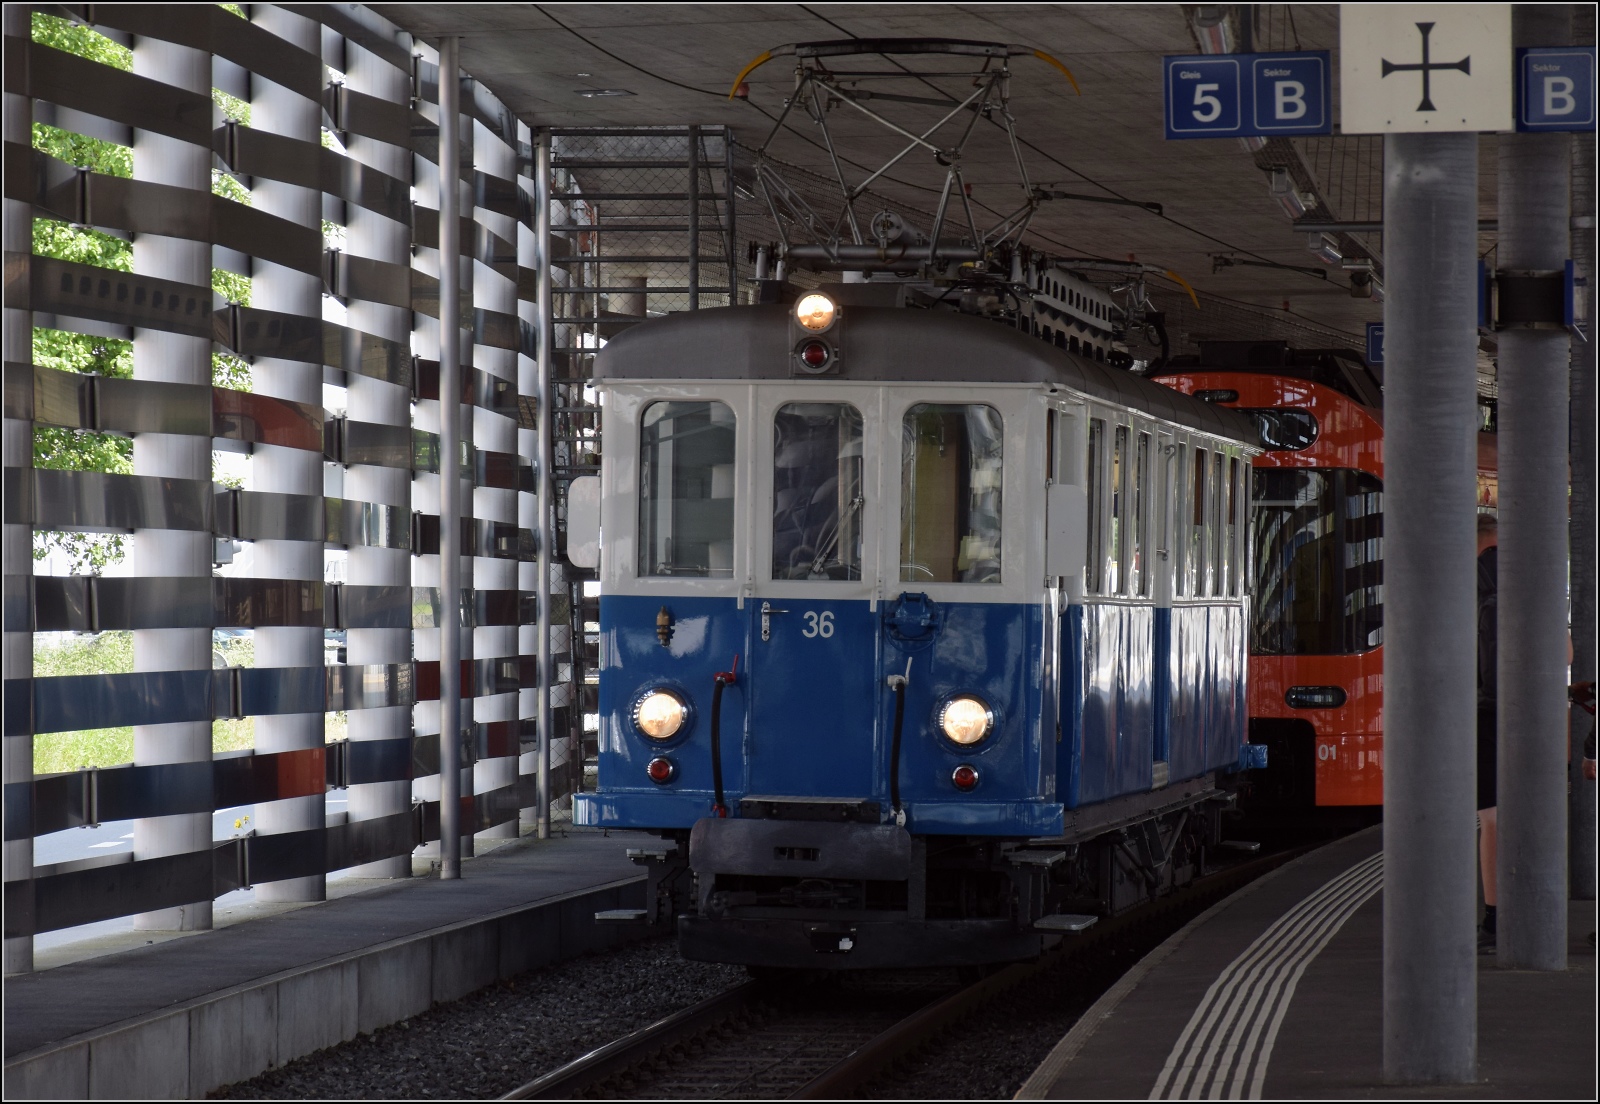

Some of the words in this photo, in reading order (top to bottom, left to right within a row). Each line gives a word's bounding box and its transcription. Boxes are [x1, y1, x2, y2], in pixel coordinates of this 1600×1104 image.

[1179, 70, 1202, 80] Gleis
[1263, 68, 1292, 77] Sektor
[1532, 63, 1561, 72] Sektor
[1192, 83, 1222, 123] 5
[1275, 80, 1307, 120] B
[1543, 76, 1576, 116] B
[802, 610, 835, 639] 36
[1317, 744, 1337, 761] 01
